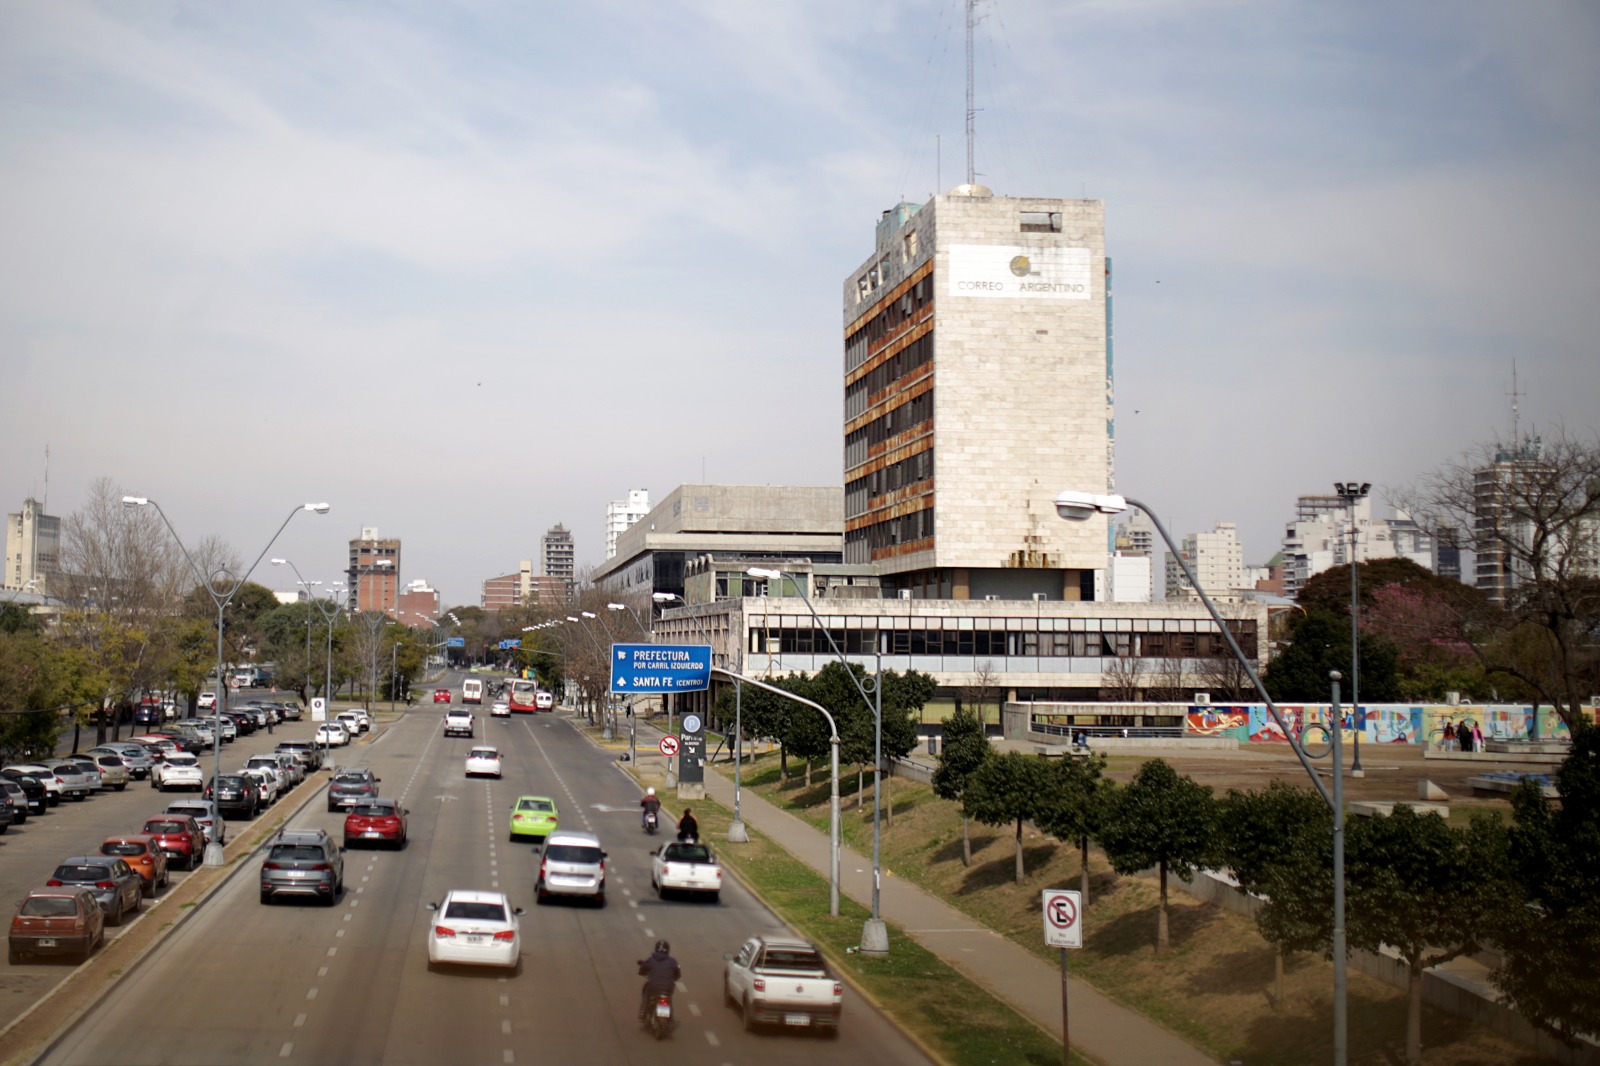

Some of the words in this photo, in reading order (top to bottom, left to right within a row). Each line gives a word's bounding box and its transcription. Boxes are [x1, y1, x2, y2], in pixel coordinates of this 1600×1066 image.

[957, 281, 1004, 291] CORREO
[1019, 282, 1085, 293] ARGENTINO
[633, 650, 690, 661] PREFECTURA
[633, 661, 647, 669] POR
[647, 662, 669, 670] CARRIL
[670, 662, 704, 670] IZQUIERDO
[633, 676, 660, 687] SANTA
[662, 677, 673, 687] FE
[676, 679, 703, 687] (CENTRO)
